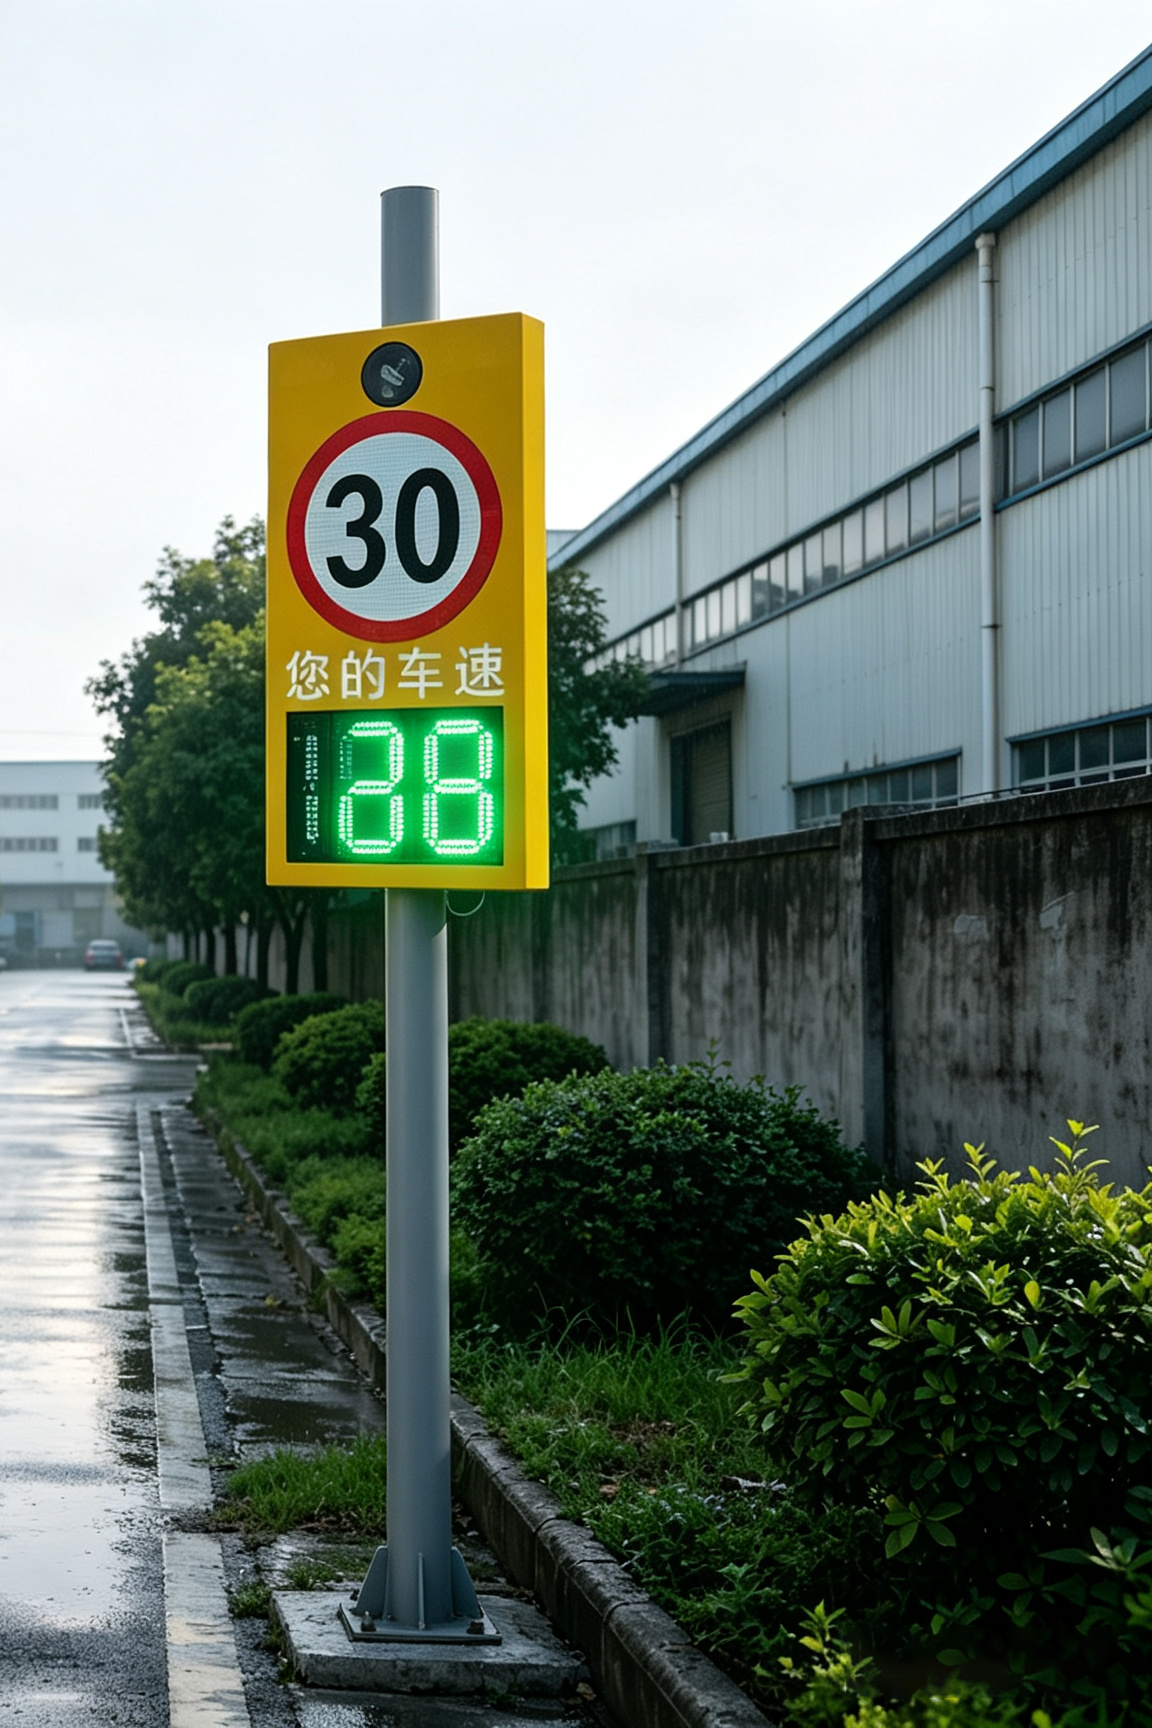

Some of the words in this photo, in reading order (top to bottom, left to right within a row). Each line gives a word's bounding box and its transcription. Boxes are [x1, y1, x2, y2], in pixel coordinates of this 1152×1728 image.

[325, 467, 460, 588] 30
[286, 642, 505, 701] 您的车速
